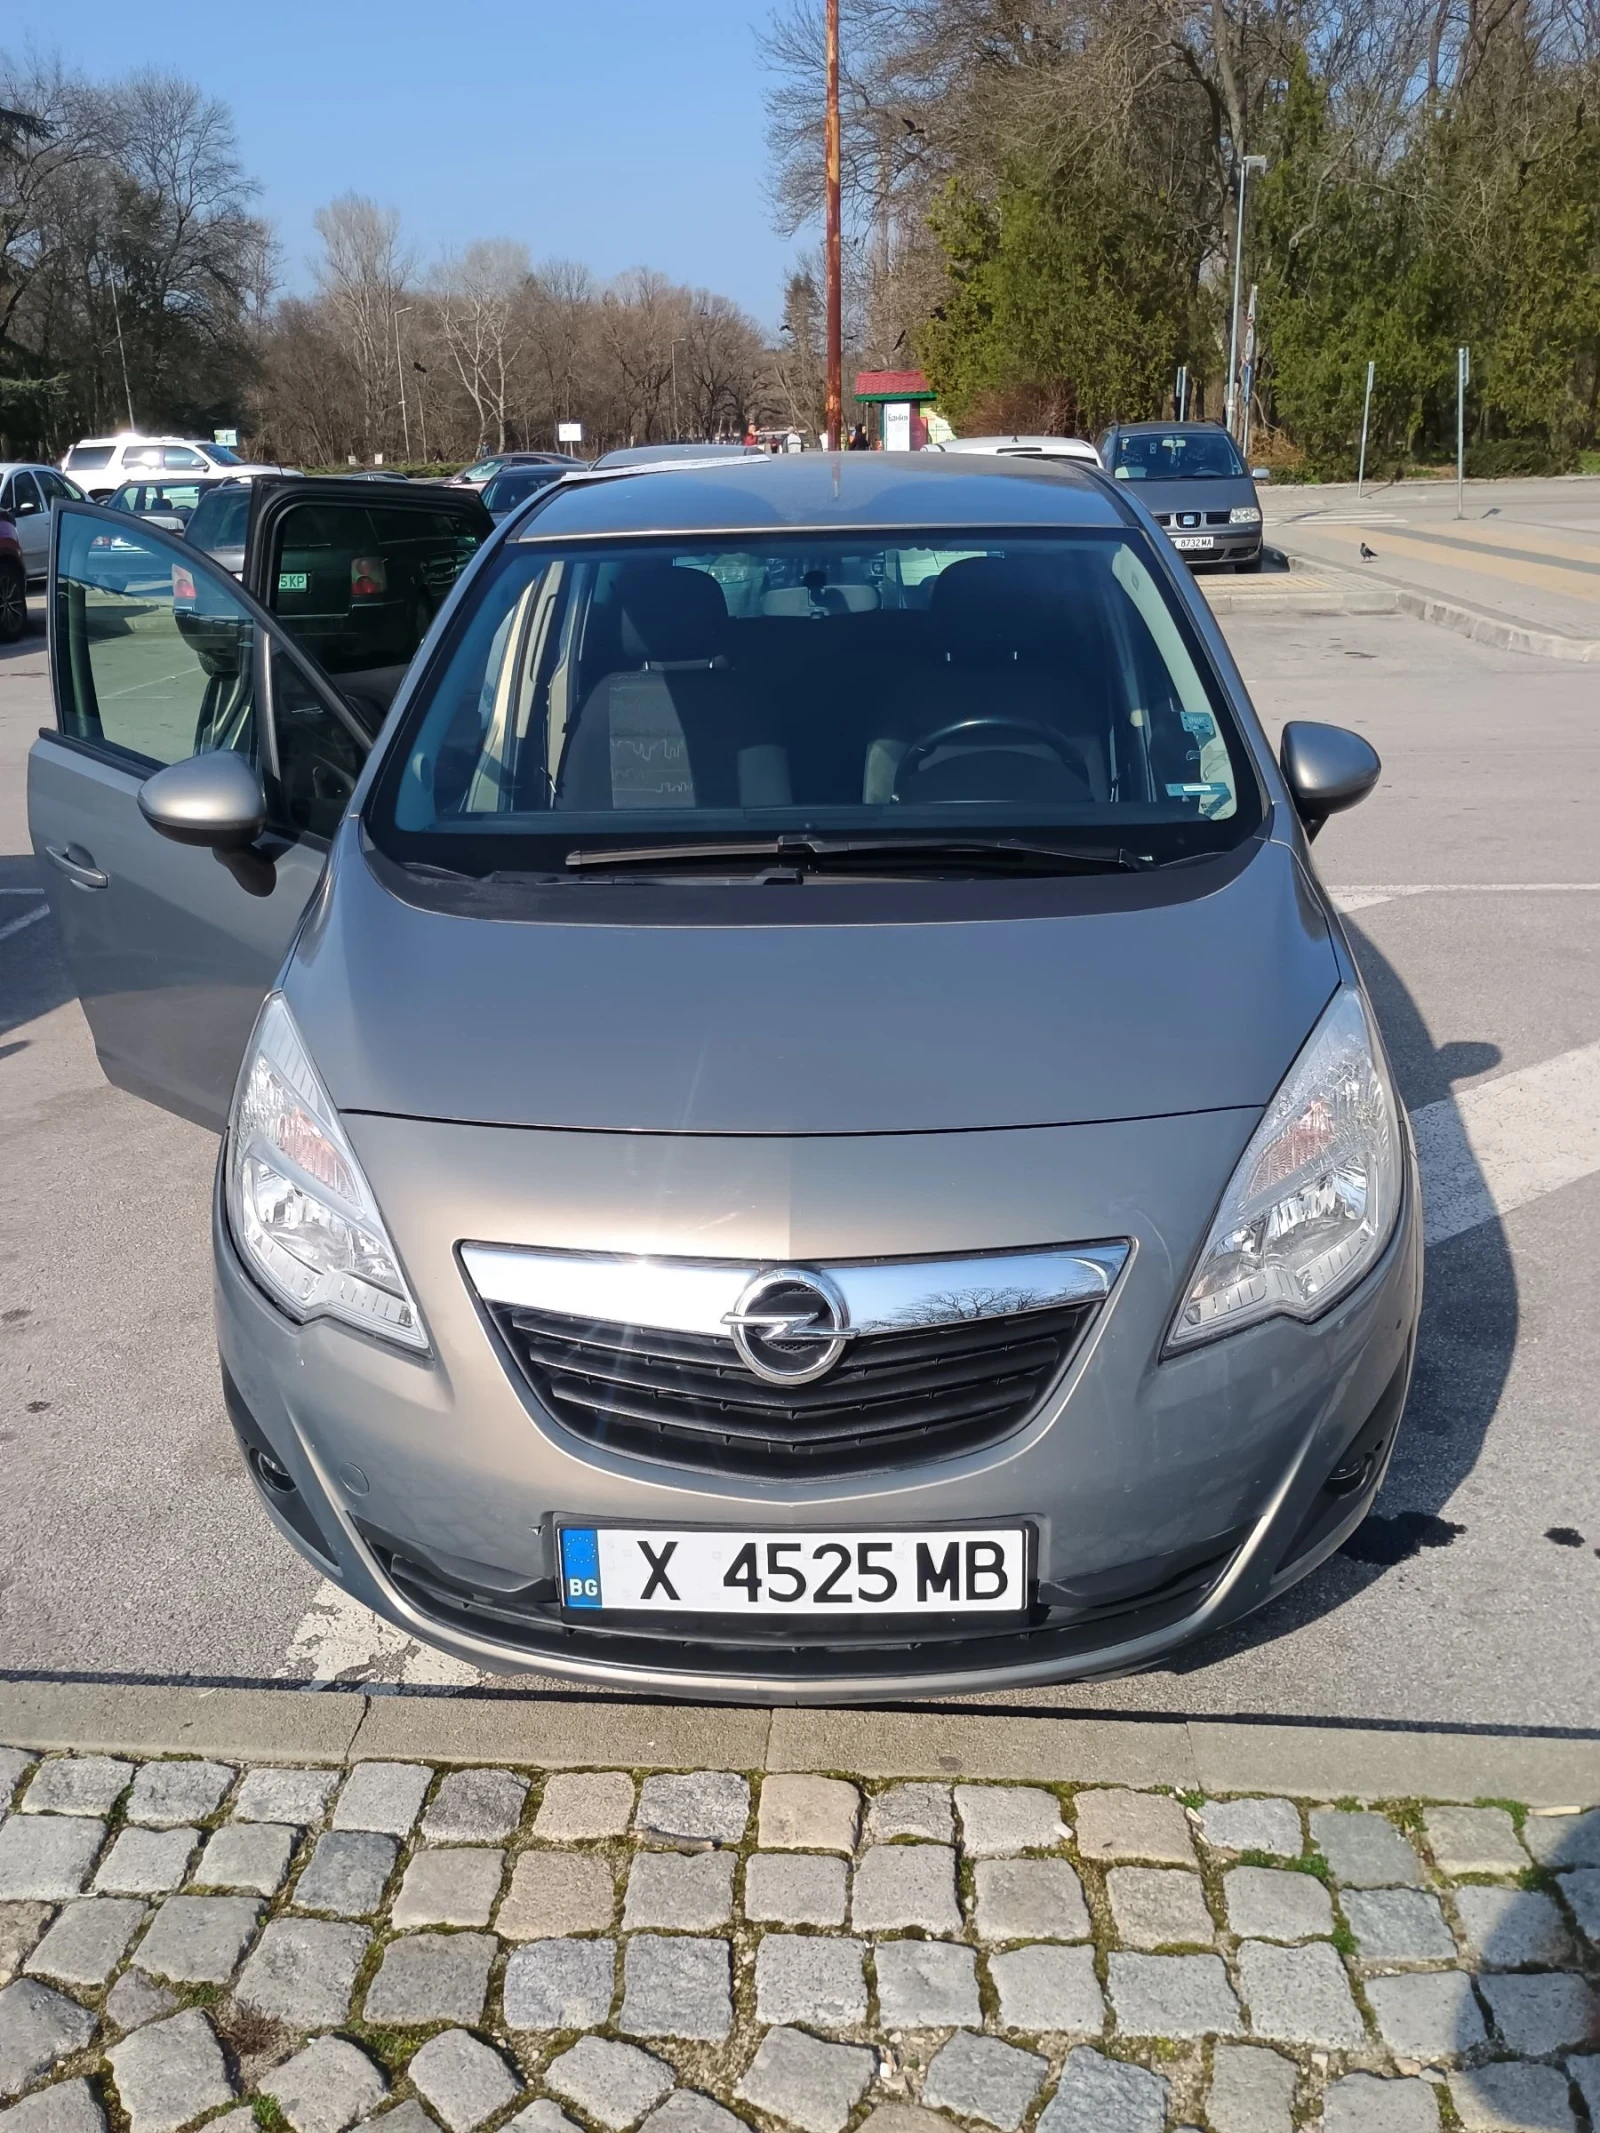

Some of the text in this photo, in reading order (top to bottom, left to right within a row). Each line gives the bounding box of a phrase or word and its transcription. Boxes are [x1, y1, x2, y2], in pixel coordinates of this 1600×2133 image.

[569, 1540, 1009, 1603] BG X 4525 MB
